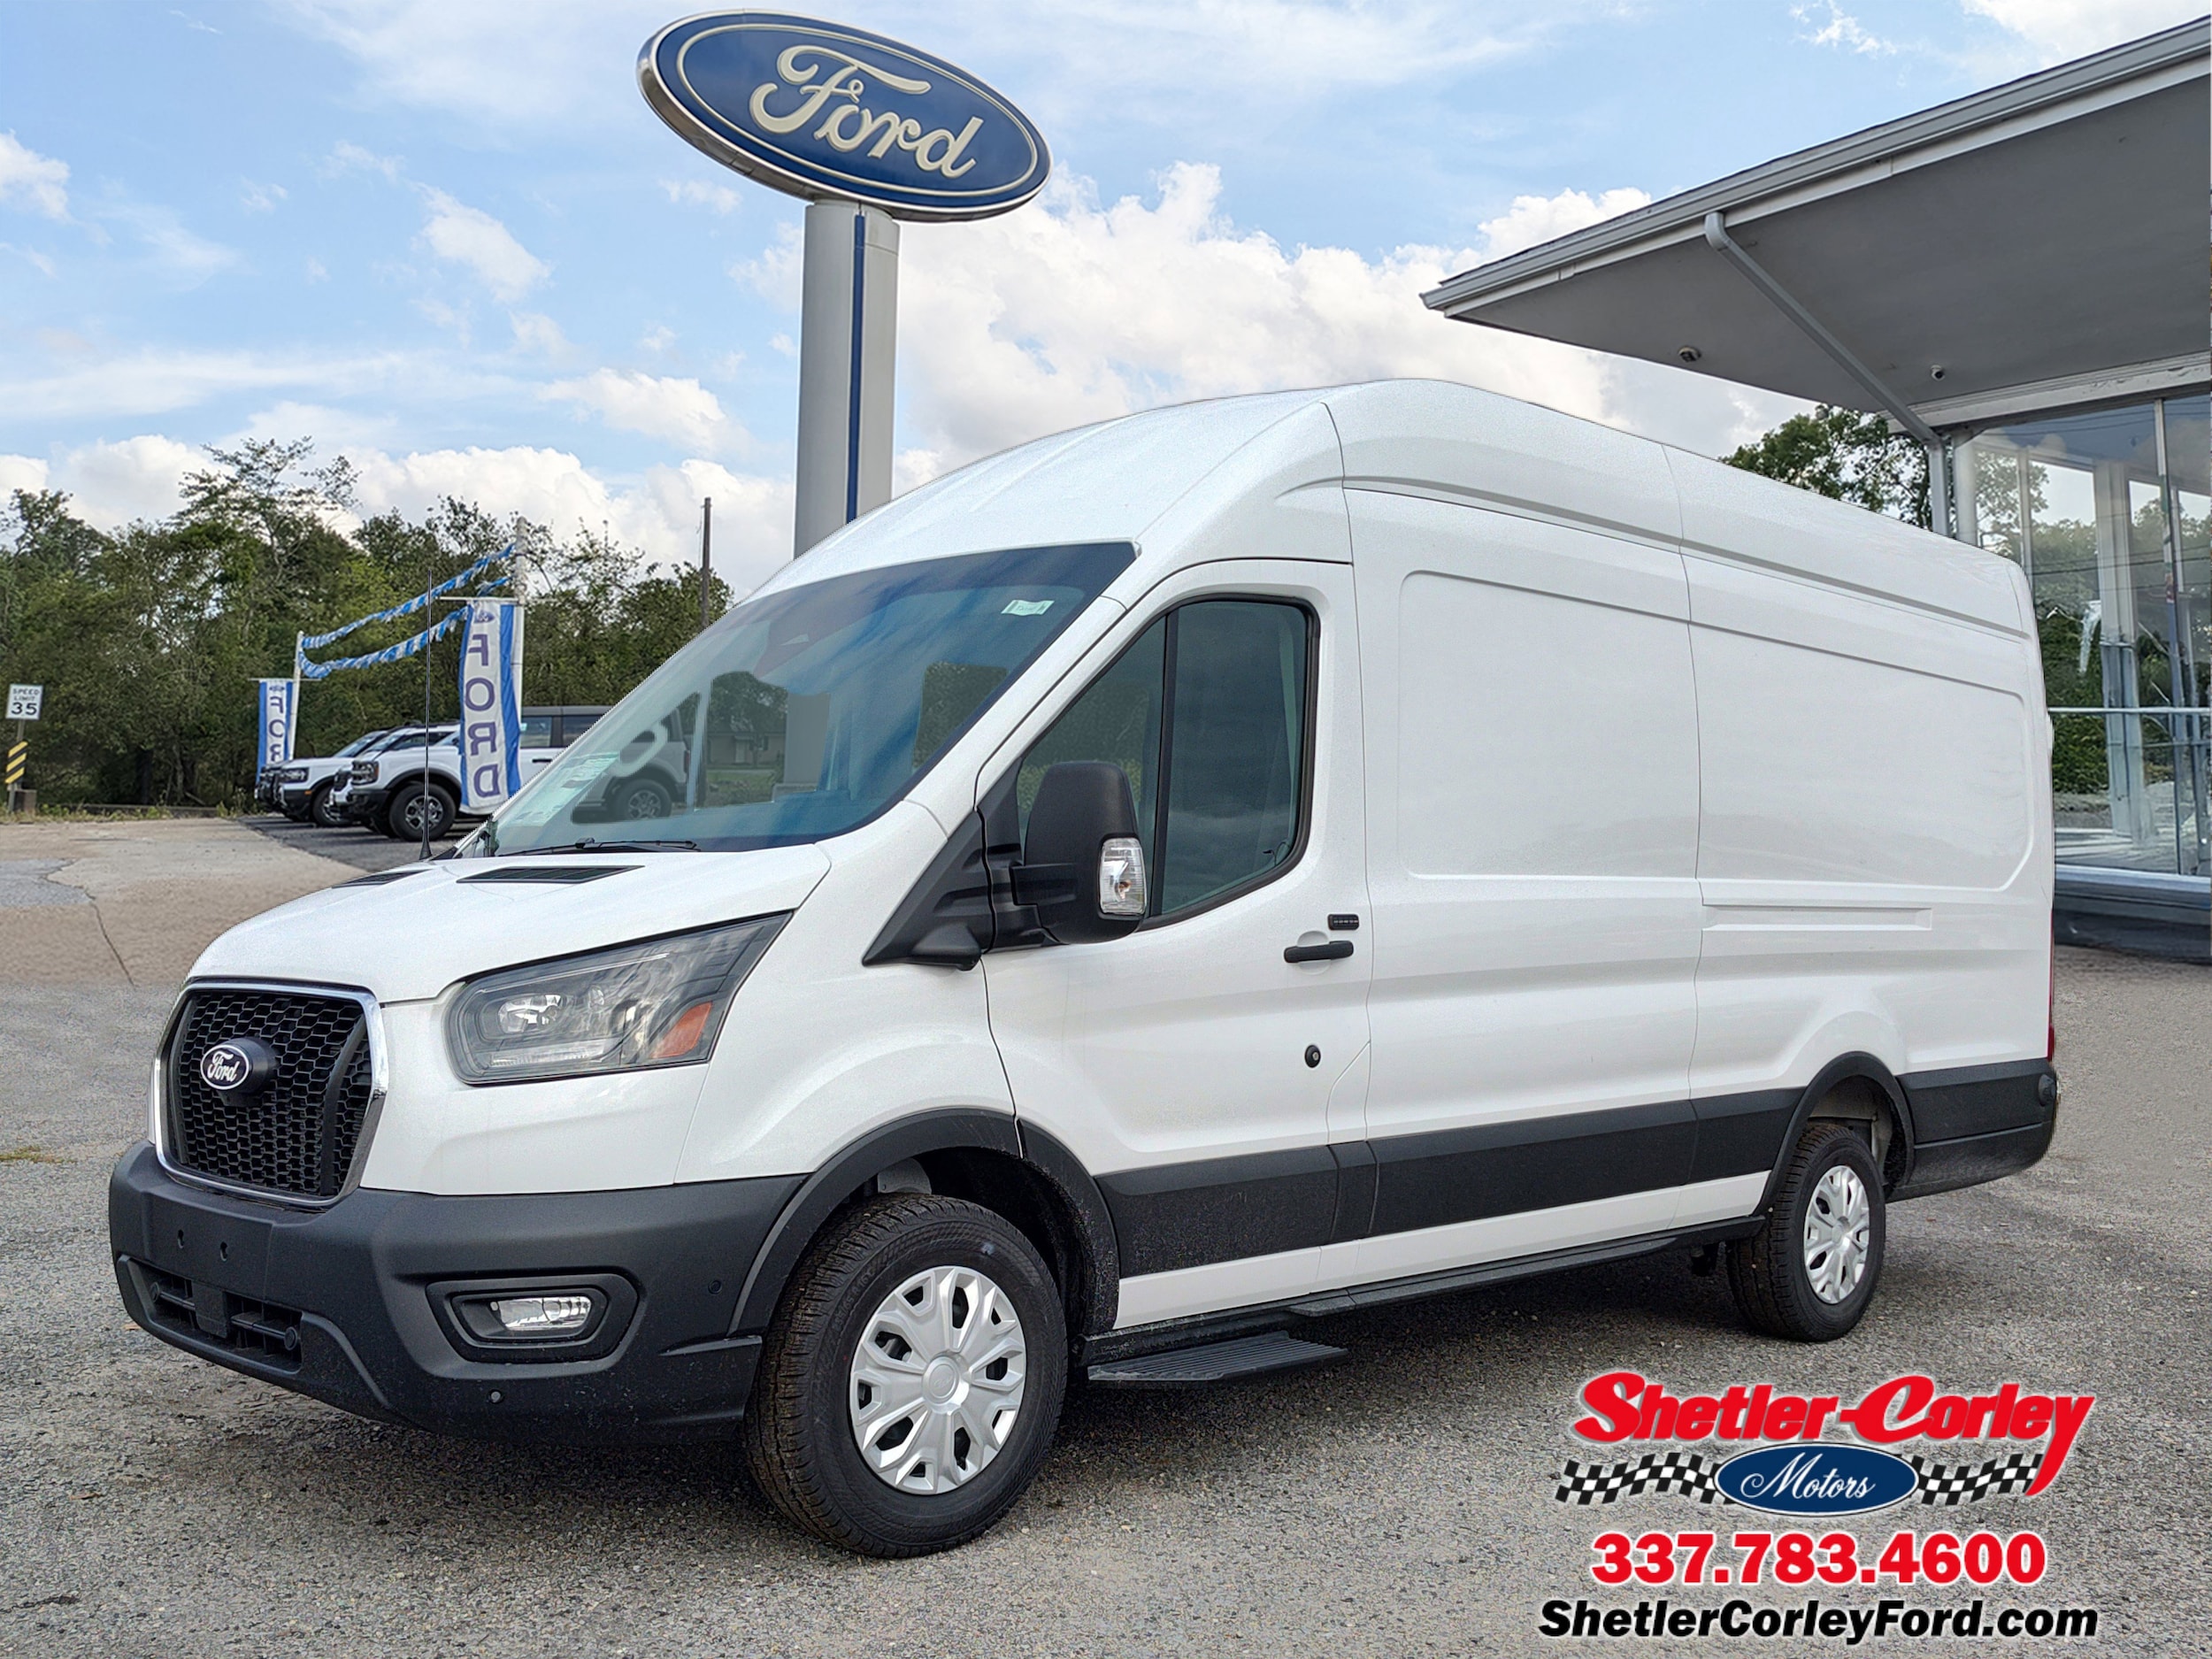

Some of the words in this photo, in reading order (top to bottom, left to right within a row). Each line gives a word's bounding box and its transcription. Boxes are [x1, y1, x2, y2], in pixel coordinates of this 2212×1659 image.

[749, 45, 984, 179] Ford
[12, 702, 37, 716] 35
[207, 1050, 241, 1082] Ford
